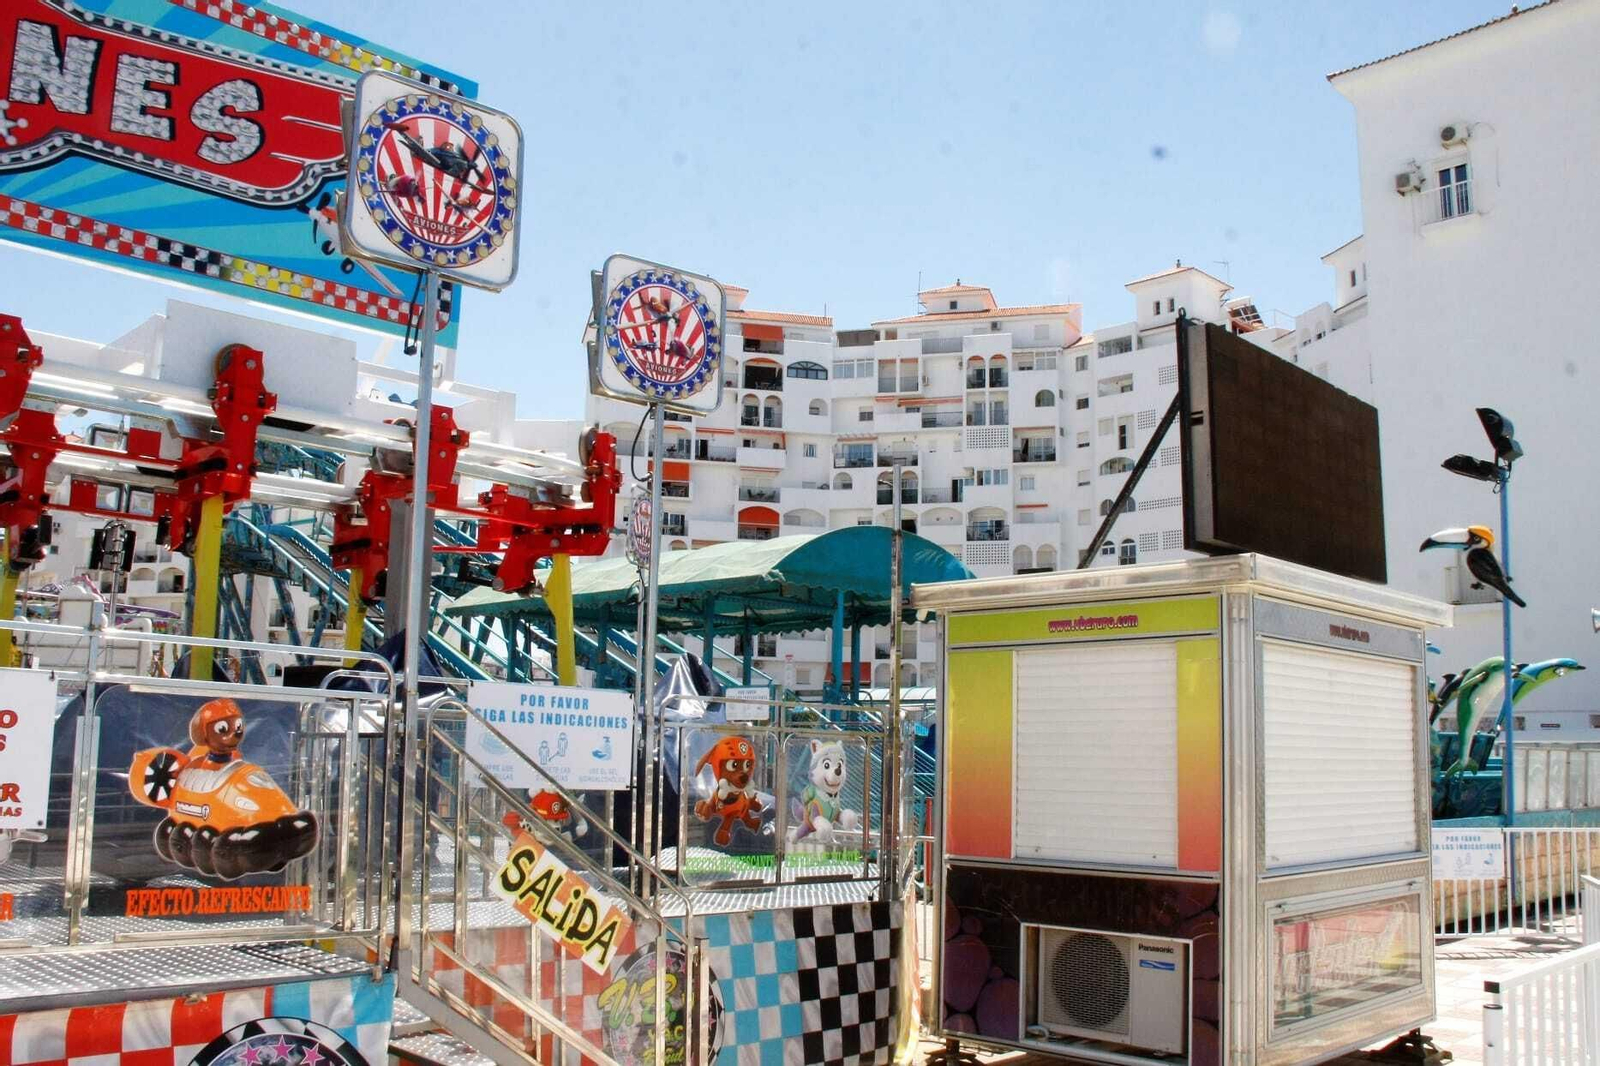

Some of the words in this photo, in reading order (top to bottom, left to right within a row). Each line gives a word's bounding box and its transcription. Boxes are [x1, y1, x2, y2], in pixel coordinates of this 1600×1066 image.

[8, 19, 265, 165] NES
[413, 215, 456, 236] AVIONES
[646, 361, 677, 374] AVIONES
[520, 694, 545, 707] POR
[551, 696, 589, 710] FAVOR
[512, 711, 535, 724] LAS
[541, 712, 628, 729] INDICACIONES
[126, 888, 194, 917] EFECTO
[194, 885, 312, 915] REFRESCANTE
[1139, 942, 1174, 953] Panasonic
